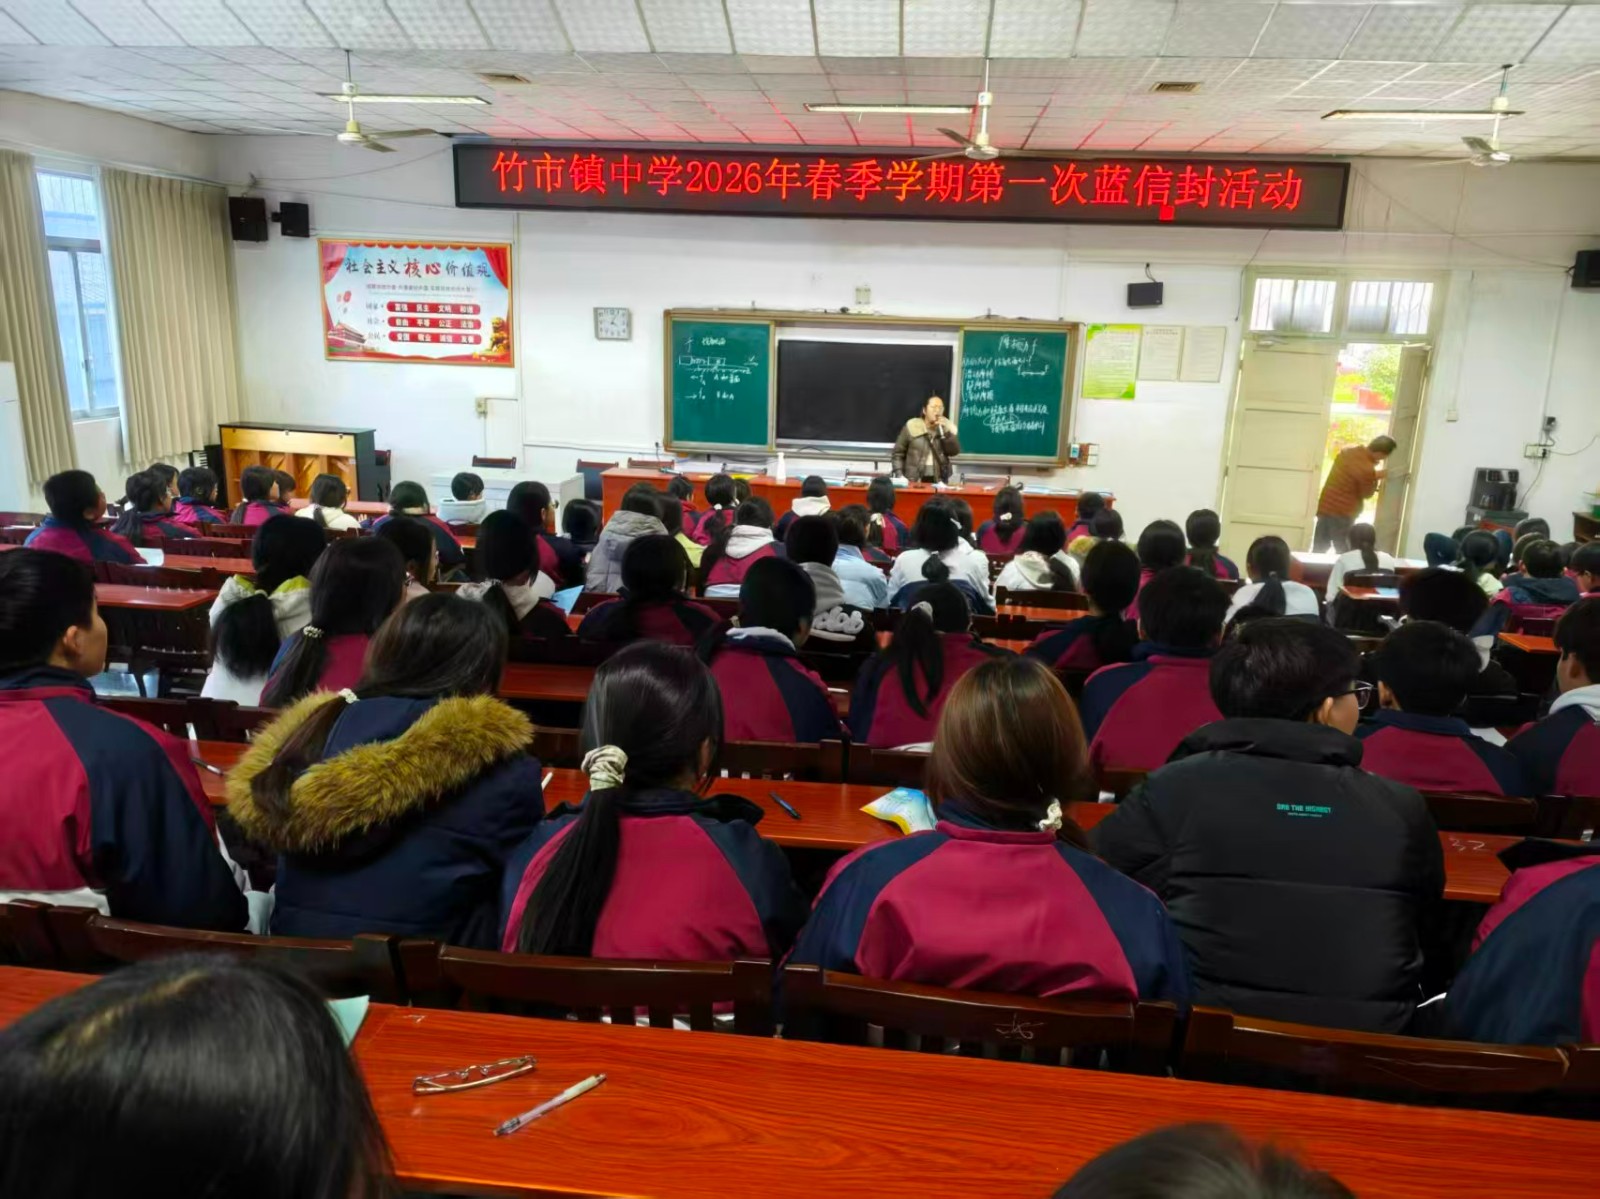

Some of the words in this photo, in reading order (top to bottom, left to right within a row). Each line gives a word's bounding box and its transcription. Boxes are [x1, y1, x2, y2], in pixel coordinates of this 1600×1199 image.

[492, 150, 1302, 211] 竹市镇中学2026年春季学期第一次蓝信封活动
[345, 256, 491, 278] 社会主义核心价值观
